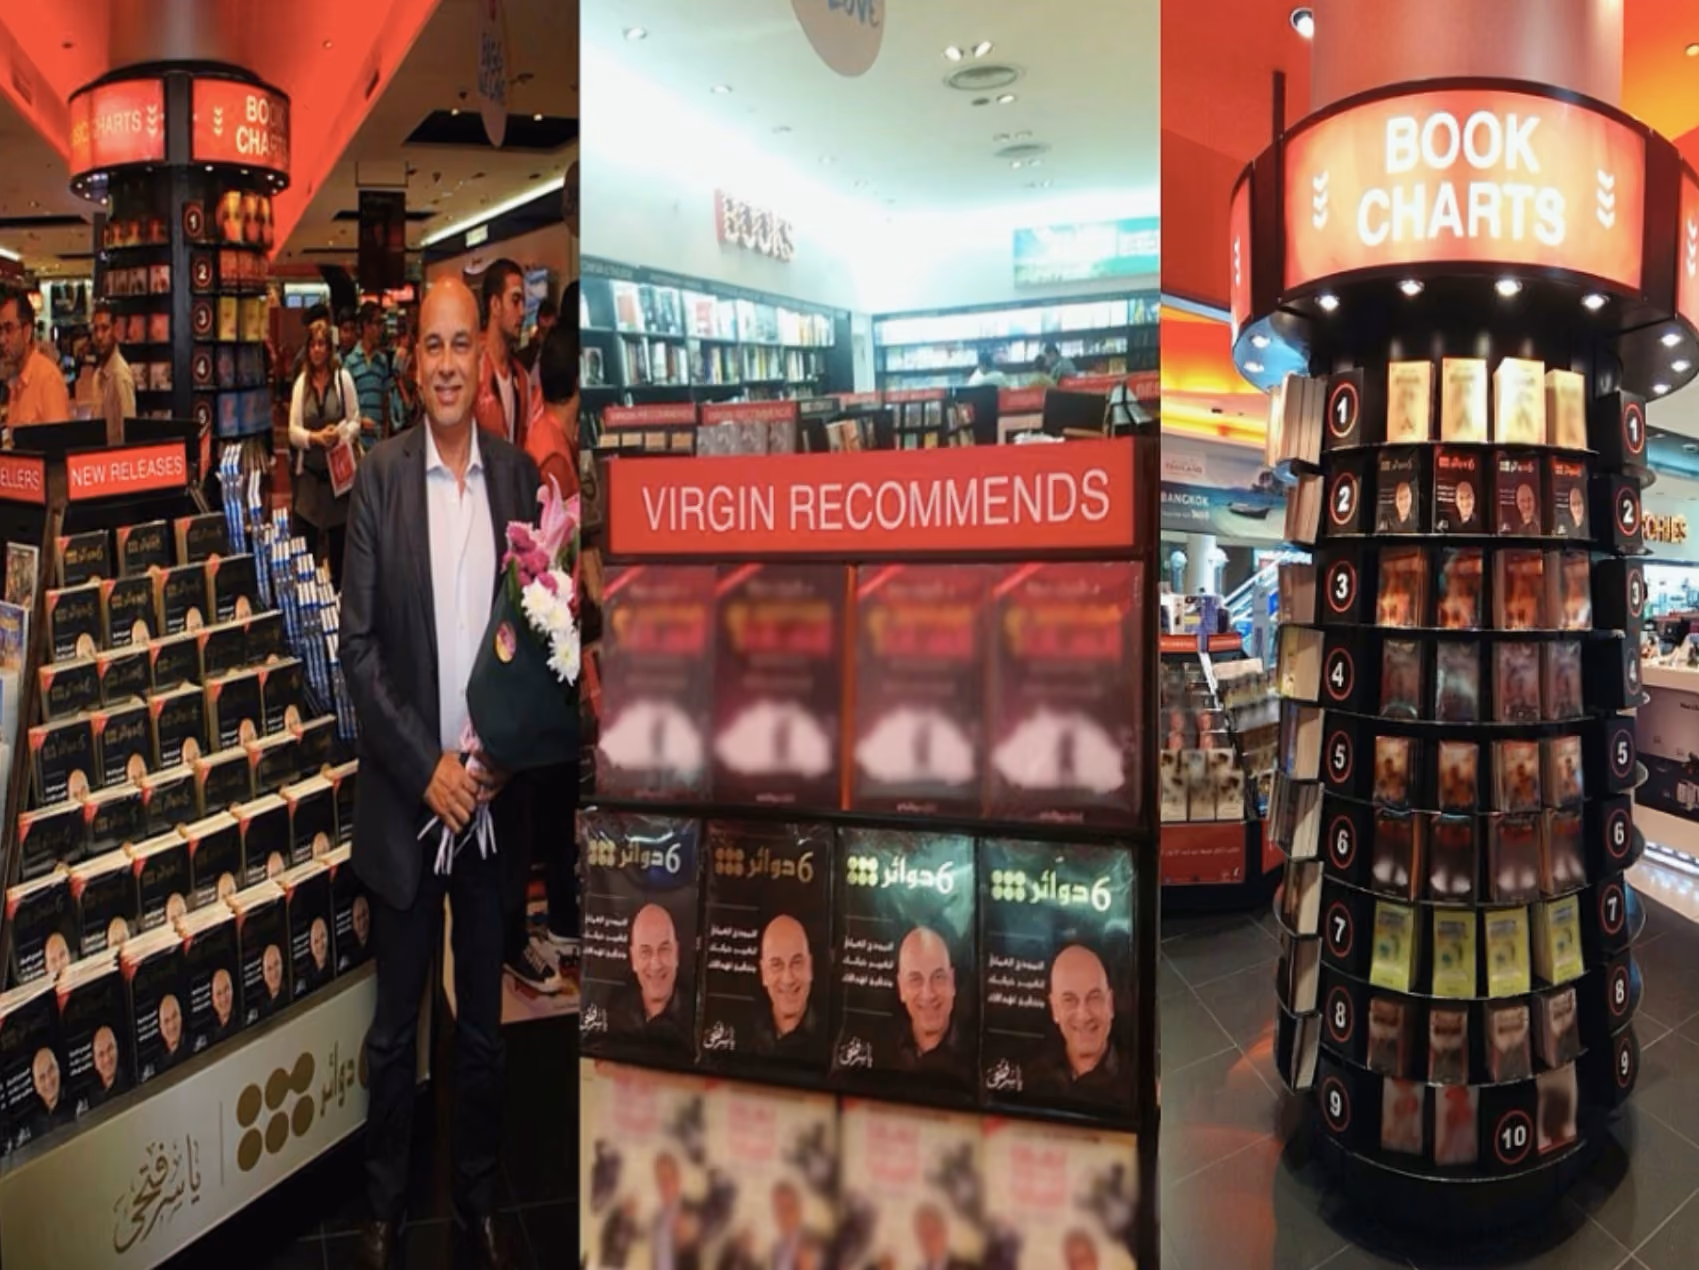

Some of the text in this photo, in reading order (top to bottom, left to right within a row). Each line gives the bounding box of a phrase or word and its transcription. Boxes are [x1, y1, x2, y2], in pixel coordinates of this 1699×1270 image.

[1386, 110, 1541, 174] BOOK
[1357, 181, 1566, 247] CHARTS
[1337, 397, 1347, 424] 1
[1629, 417, 1638, 442] 1
[70, 455, 184, 487] NEW RELEASES
[642, 468, 1110, 532] VIRGIN RECOMMENDS
[1337, 486, 1351, 512] 2
[1623, 499, 1634, 524] 2
[1335, 573, 1348, 599] 3
[1632, 581, 1640, 605] 3
[1331, 662, 1344, 687] 4
[1334, 744, 1345, 769] 5
[1617, 741, 1628, 765] 5
[1337, 830, 1348, 855] 6
[1614, 821, 1625, 845] 6
[1607, 896, 1618, 921] 7
[1334, 916, 1346, 943] 7
[1615, 979, 1625, 1004] 8
[1335, 1001, 1346, 1028] 8
[1621, 1051, 1629, 1075] 9
[1330, 1090, 1342, 1117] 9
[1502, 1125, 1527, 1149] 10
